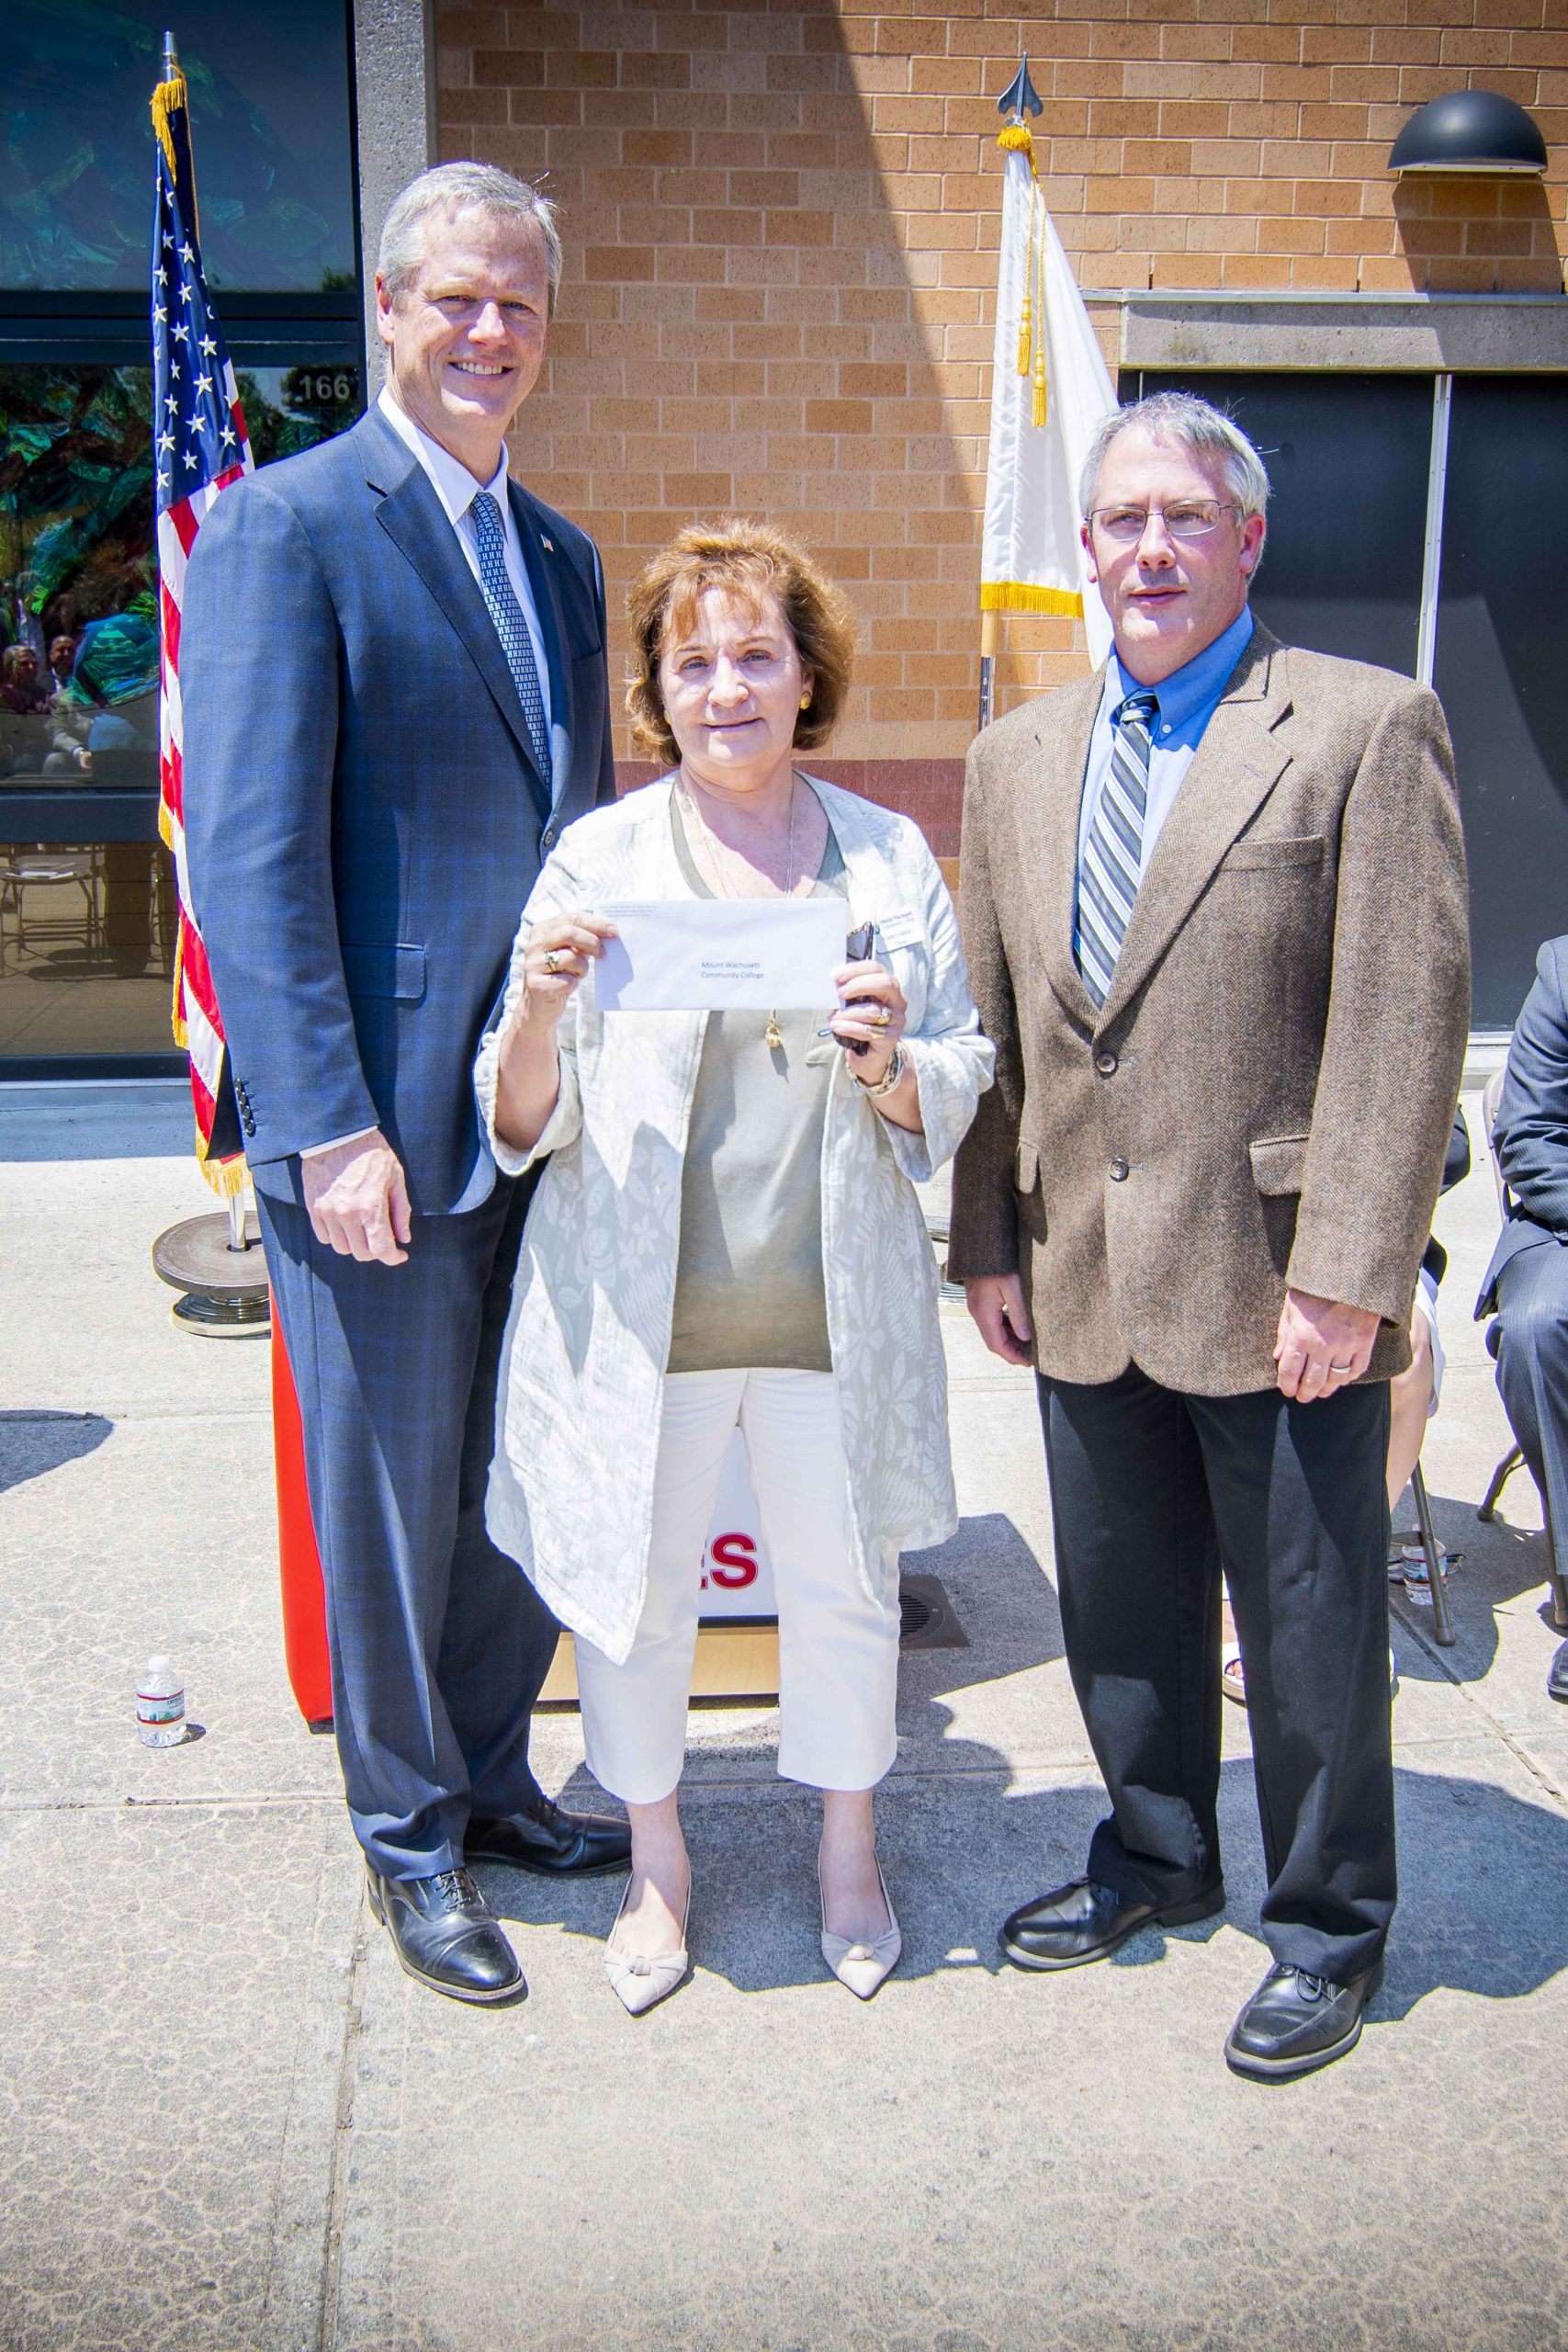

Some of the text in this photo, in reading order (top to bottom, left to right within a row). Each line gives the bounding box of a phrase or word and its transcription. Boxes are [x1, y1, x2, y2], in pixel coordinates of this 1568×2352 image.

[299, 375, 350, 400] 166
[701, 971, 764, 980] Community College
[700, 1532, 759, 1590] S
